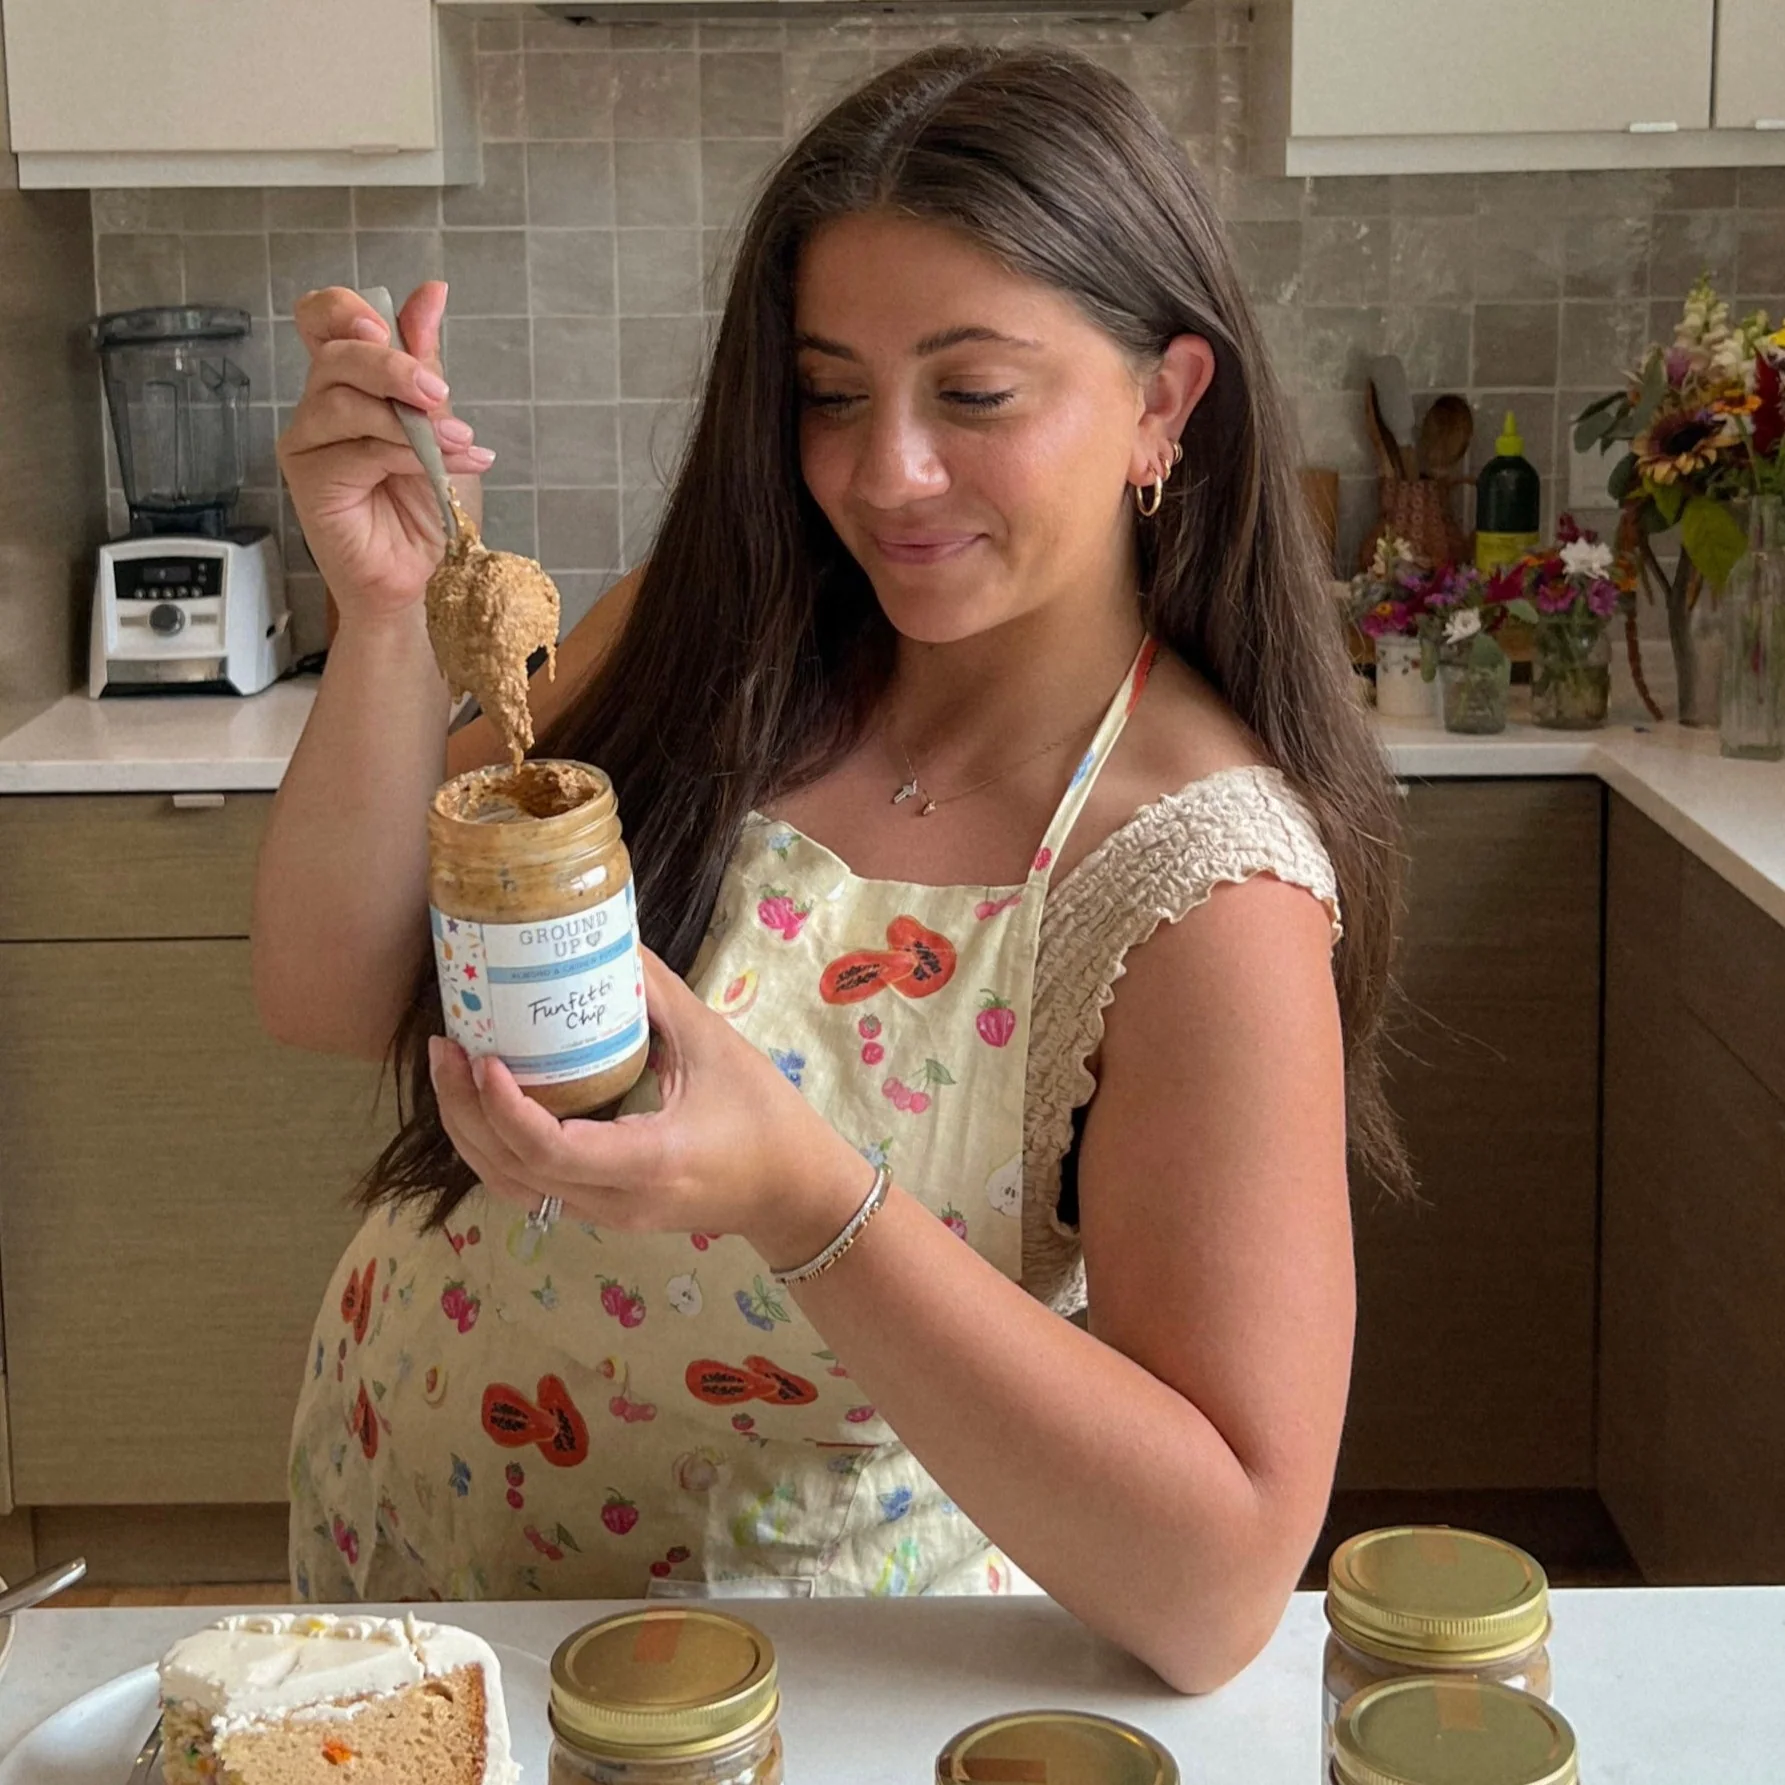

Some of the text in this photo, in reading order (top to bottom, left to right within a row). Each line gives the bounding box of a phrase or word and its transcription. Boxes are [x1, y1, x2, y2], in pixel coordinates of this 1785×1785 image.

[519, 910, 608, 945] GROUND
[554, 938, 580, 957] UP
[566, 1004, 606, 1029] Chip
